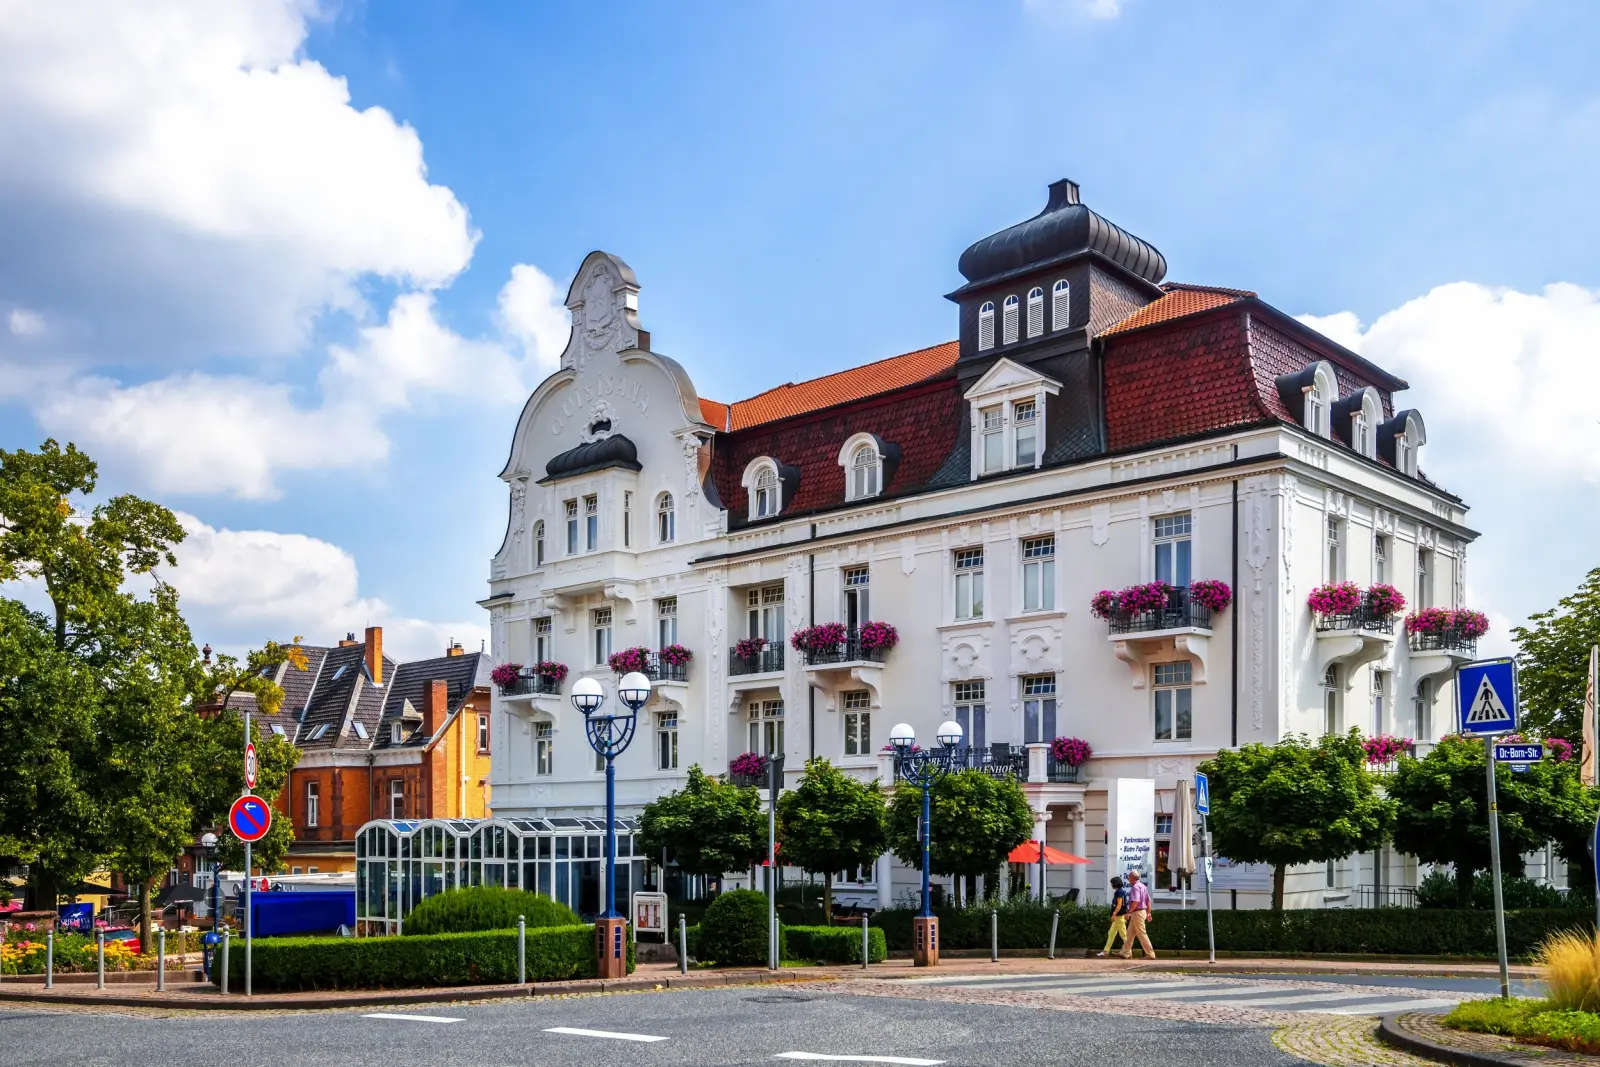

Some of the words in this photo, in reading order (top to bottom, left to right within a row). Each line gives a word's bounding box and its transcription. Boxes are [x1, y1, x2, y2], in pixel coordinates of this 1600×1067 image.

[551, 372, 651, 436] QUISISANA
[1499, 747, 1539, 759] Dr.-Born-Str.
[247, 755, 255, 776] 30
